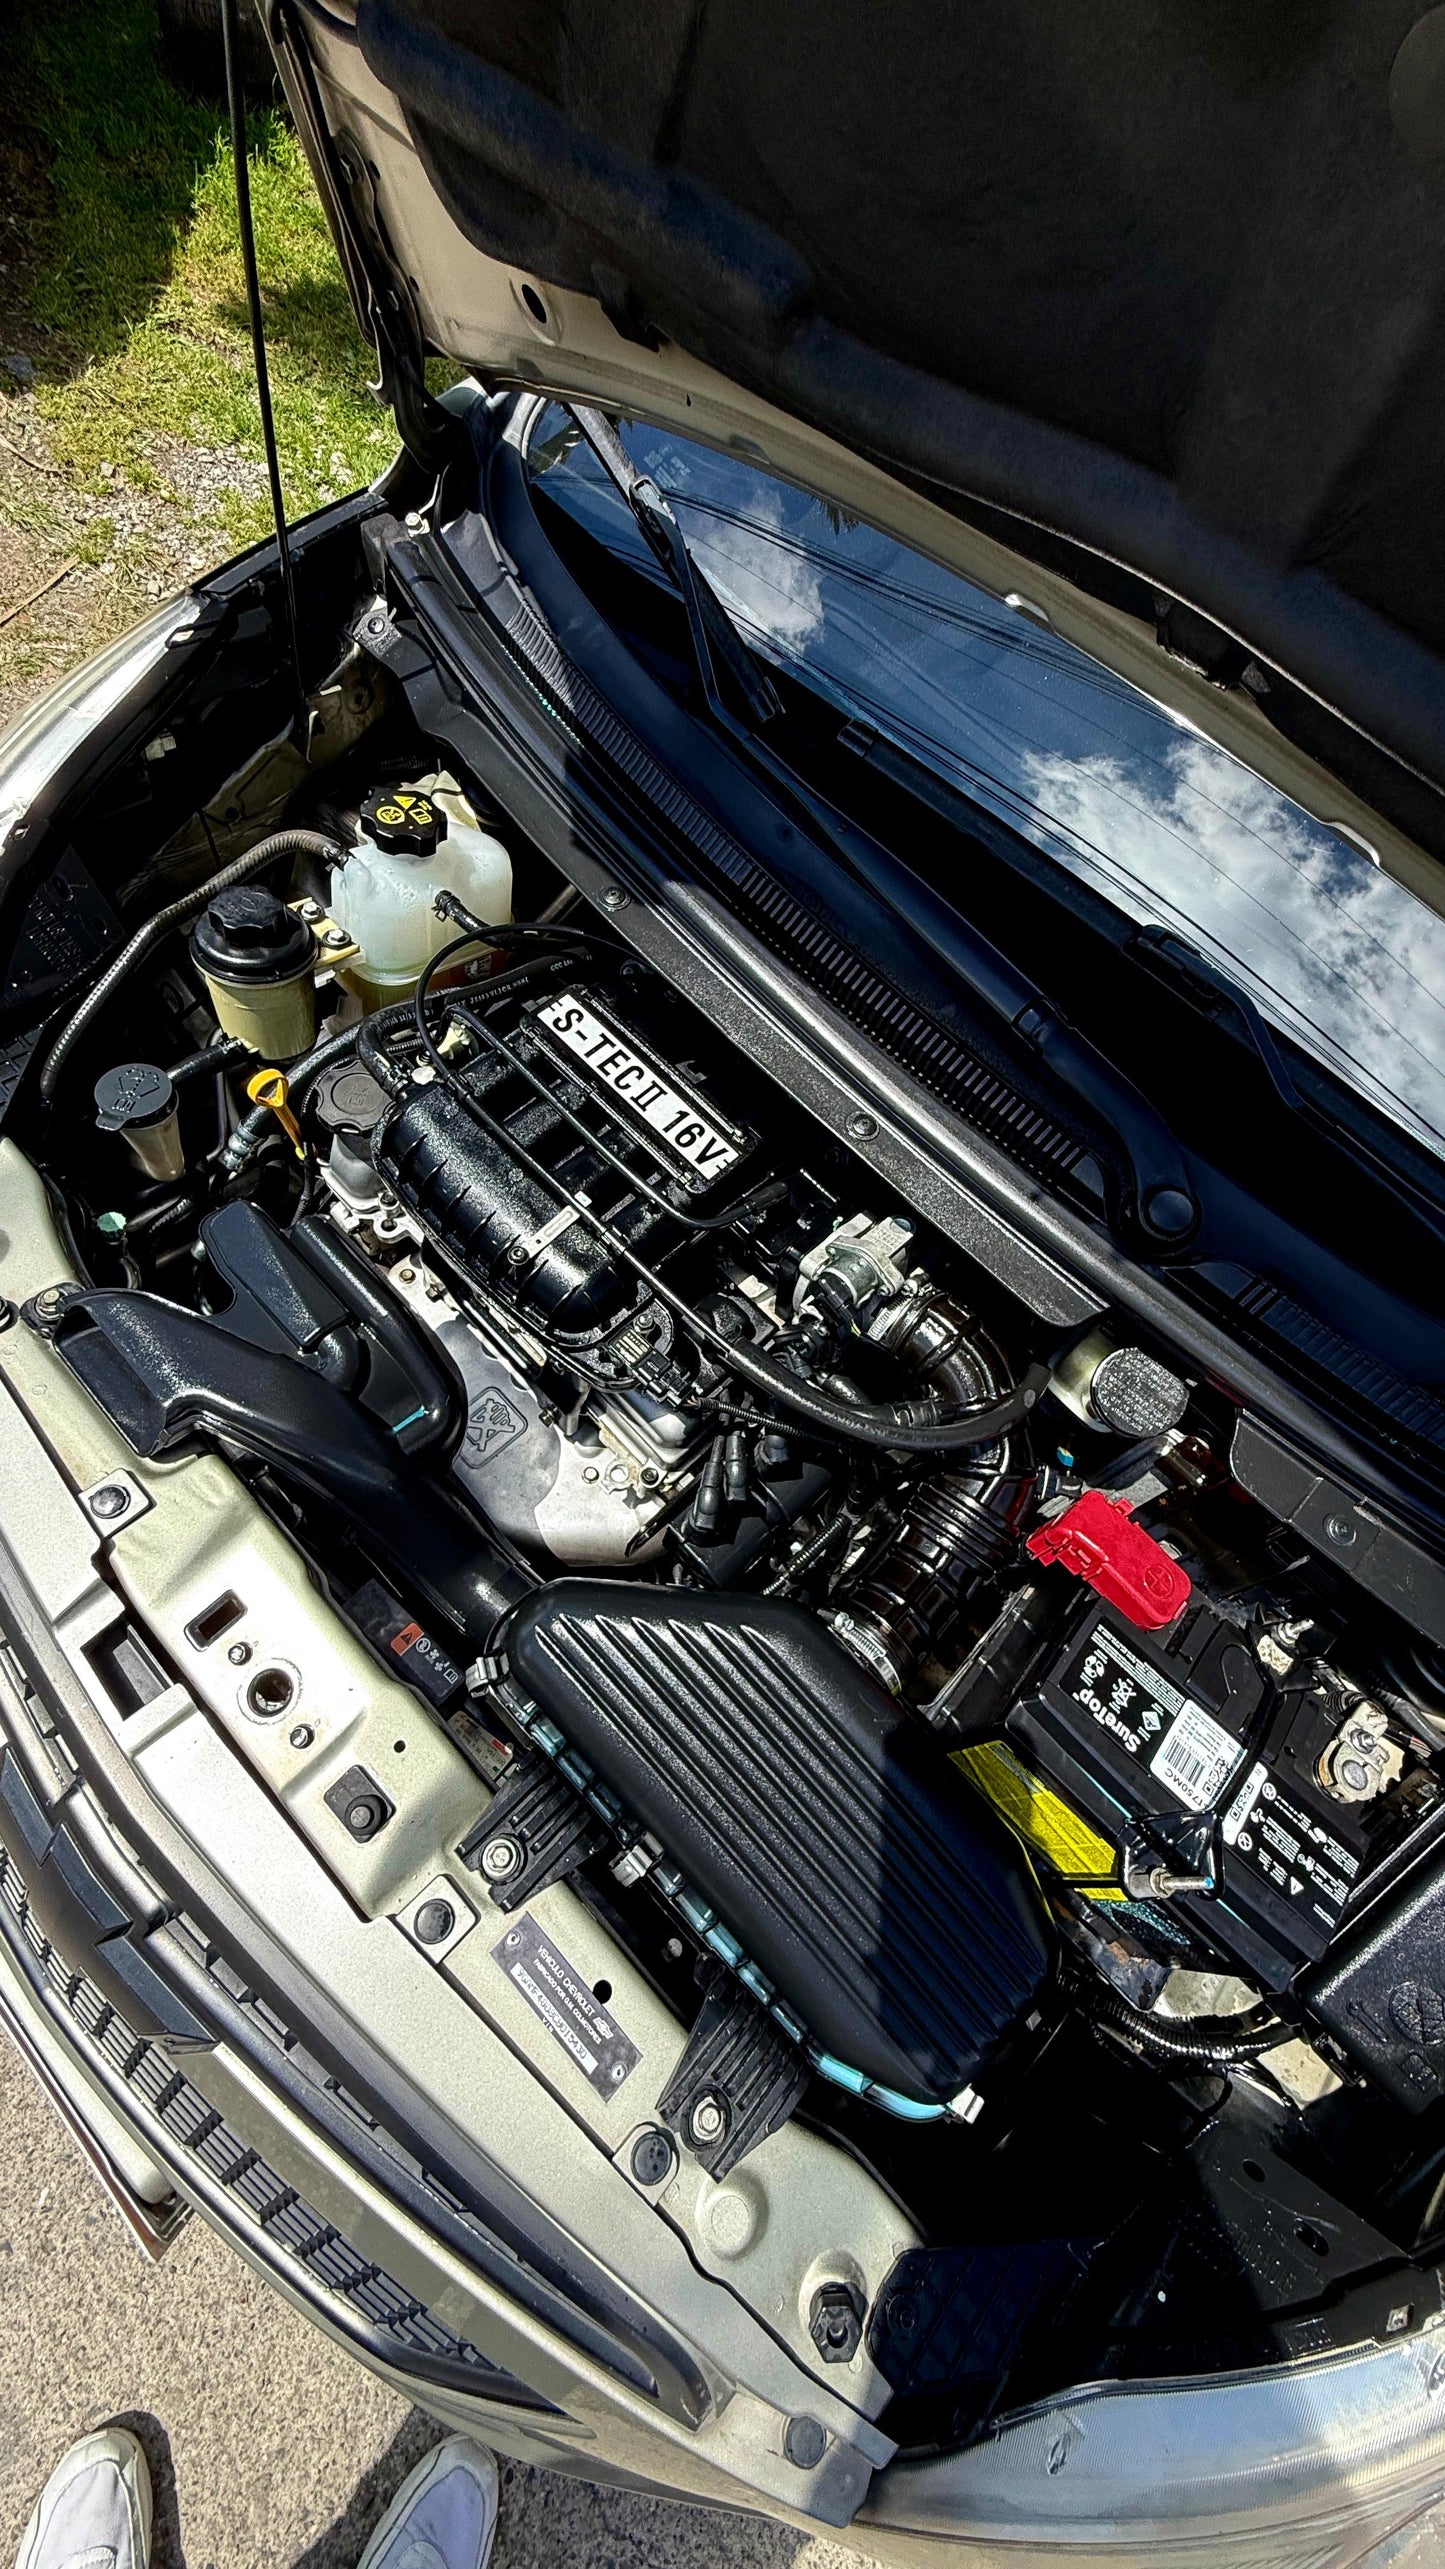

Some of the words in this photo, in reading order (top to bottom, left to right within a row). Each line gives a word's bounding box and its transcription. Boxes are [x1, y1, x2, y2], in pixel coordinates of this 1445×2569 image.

[662, 1110, 729, 1166] 16V
[1079, 1688, 1141, 1753] SureTop
[533, 1958, 557, 1988] FABRICADO
[554, 1985, 567, 2001] POR
[572, 2007, 602, 2045] COLMOTORES
[537, 1944, 564, 1979] VEHICULO
[562, 1977, 596, 2017] CHEVROLET
[541, 2016, 555, 2033] VIN
